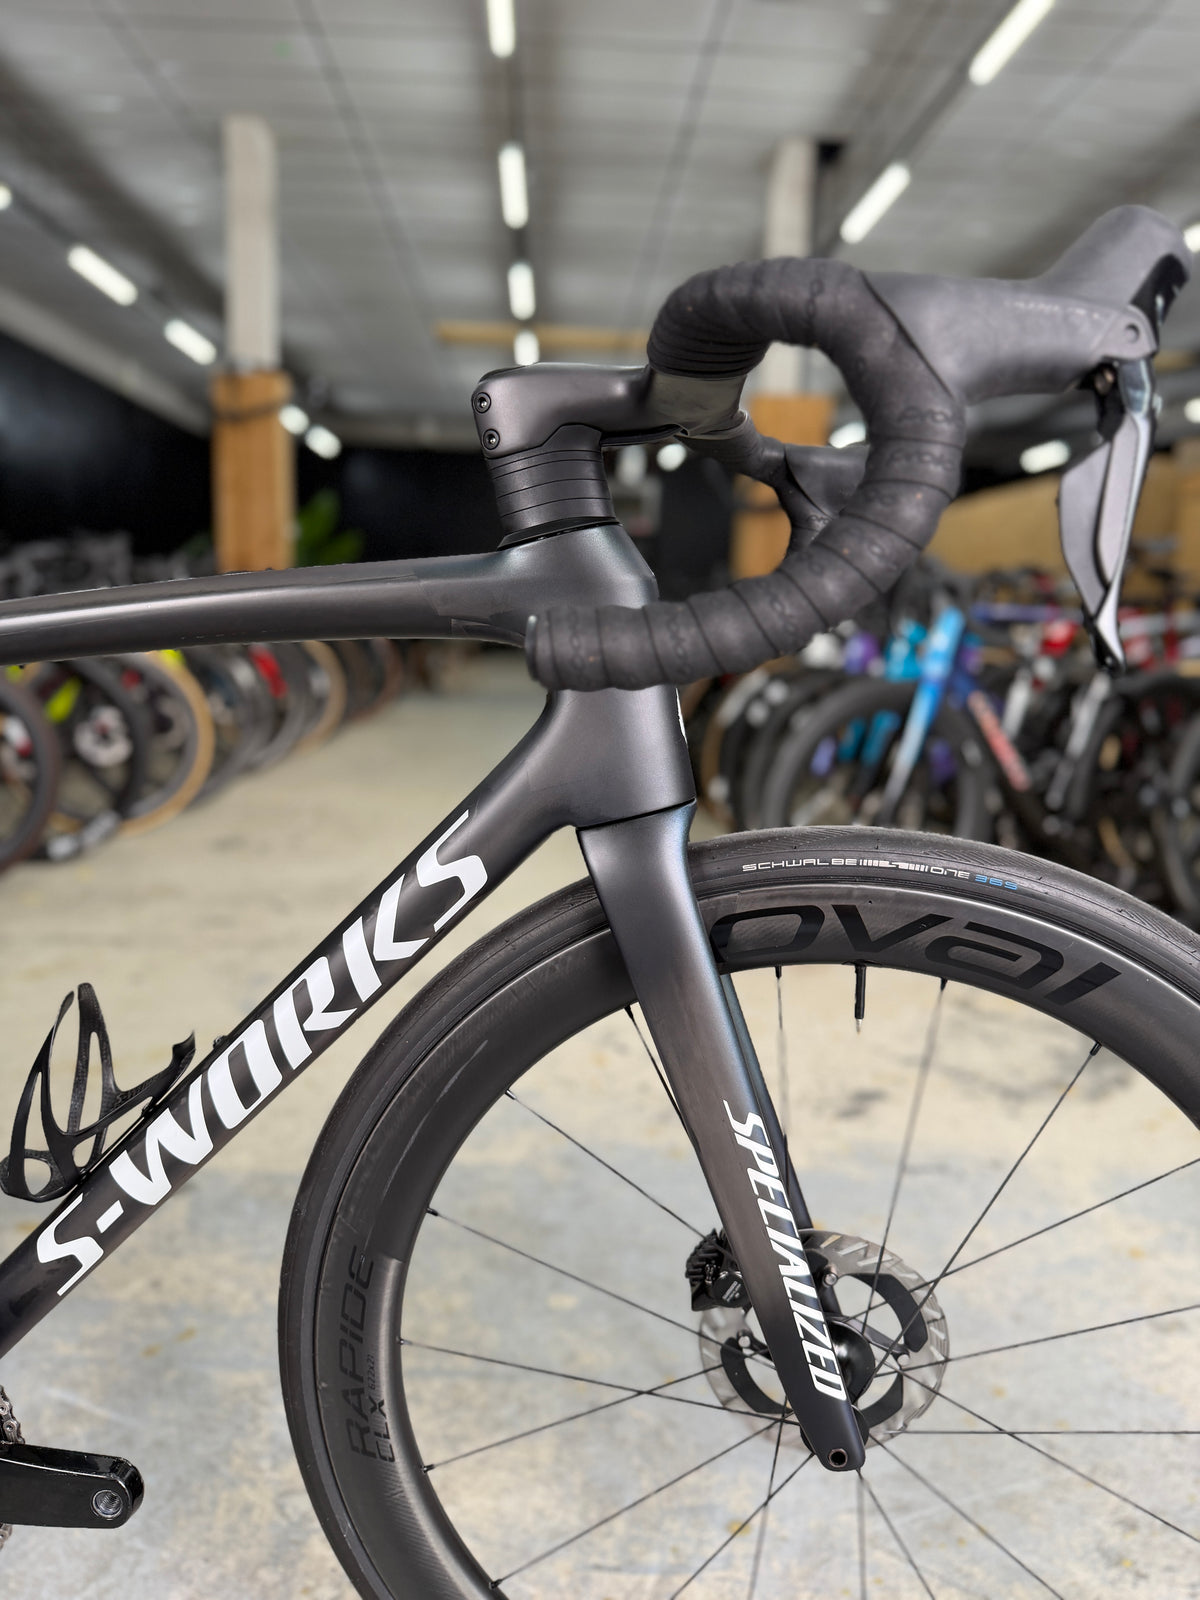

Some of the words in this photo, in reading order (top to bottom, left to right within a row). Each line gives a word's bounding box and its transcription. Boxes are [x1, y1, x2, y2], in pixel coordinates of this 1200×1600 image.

[741, 857, 858, 872] SCHWALBE
[974, 873, 1019, 891] 365
[36, 809, 489, 1297] S-WORKS
[722, 1099, 848, 1402] SPECIALIZED
[368, 1398, 396, 1463] CLX
